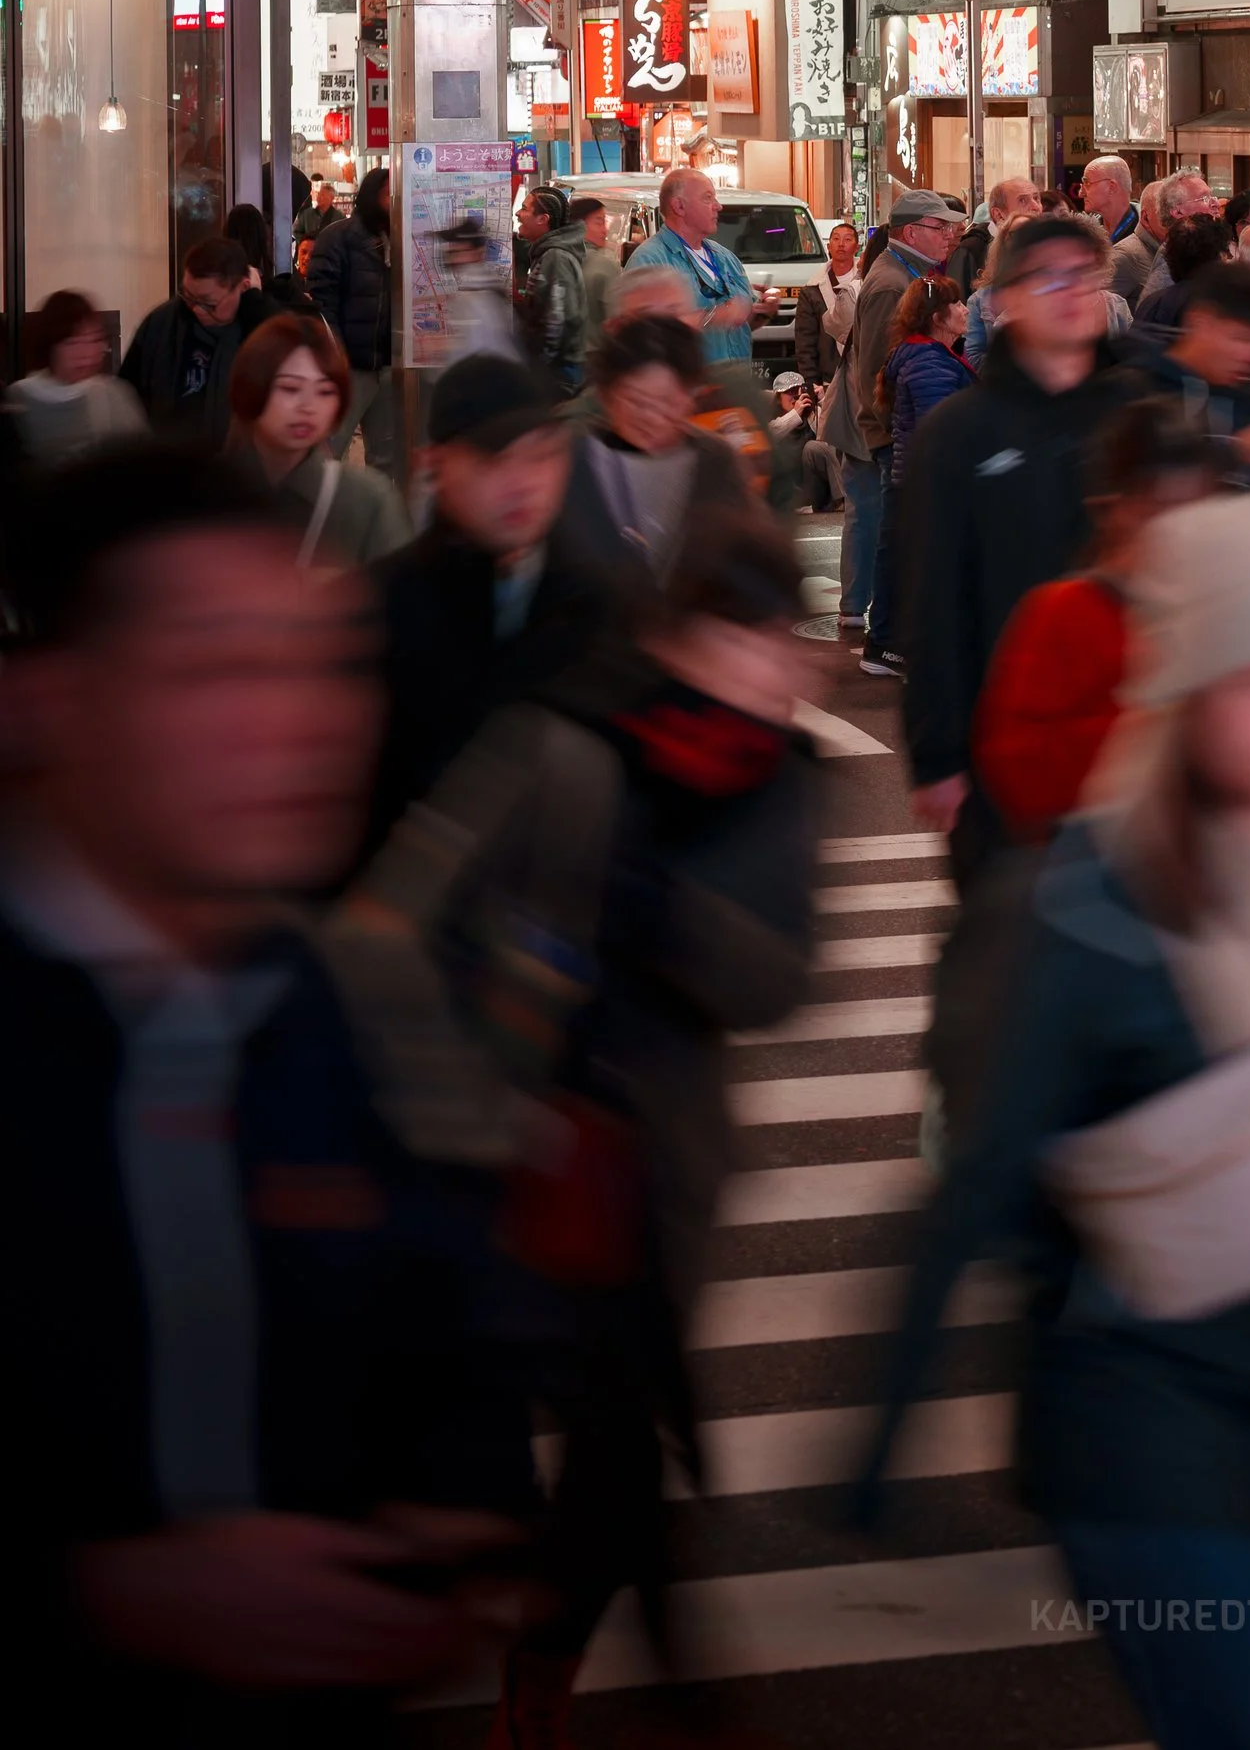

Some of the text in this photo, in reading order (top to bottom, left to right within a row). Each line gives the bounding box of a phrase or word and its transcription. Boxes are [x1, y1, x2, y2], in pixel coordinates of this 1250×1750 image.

[793, 43, 803, 96] TEPPANYAKI
[593, 104, 624, 113] ITALIAN
[818, 122, 847, 137] B1F
